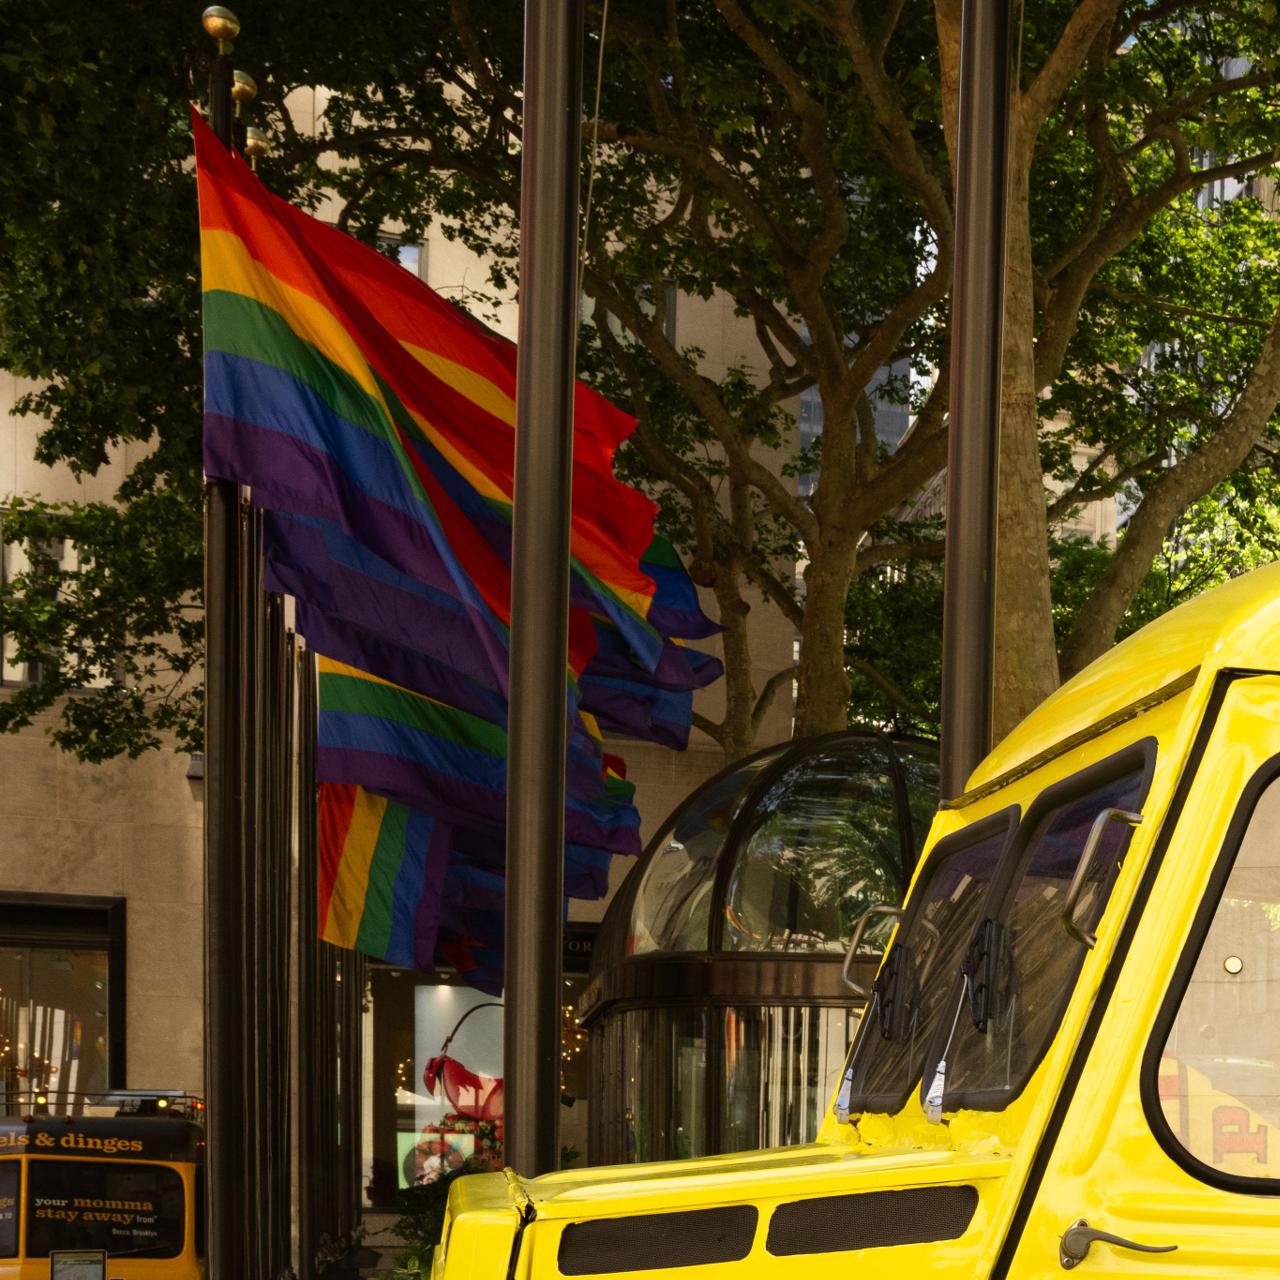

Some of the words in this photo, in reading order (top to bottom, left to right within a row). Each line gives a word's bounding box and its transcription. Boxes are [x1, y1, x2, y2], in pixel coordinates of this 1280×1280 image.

[35, 1132, 56, 1147] &
[60, 1133, 143, 1153] dinges
[34, 1198, 69, 1206] your
[73, 1198, 154, 1211] momma
[35, 1208, 78, 1222] stay
[83, 1211, 135, 1225] away
